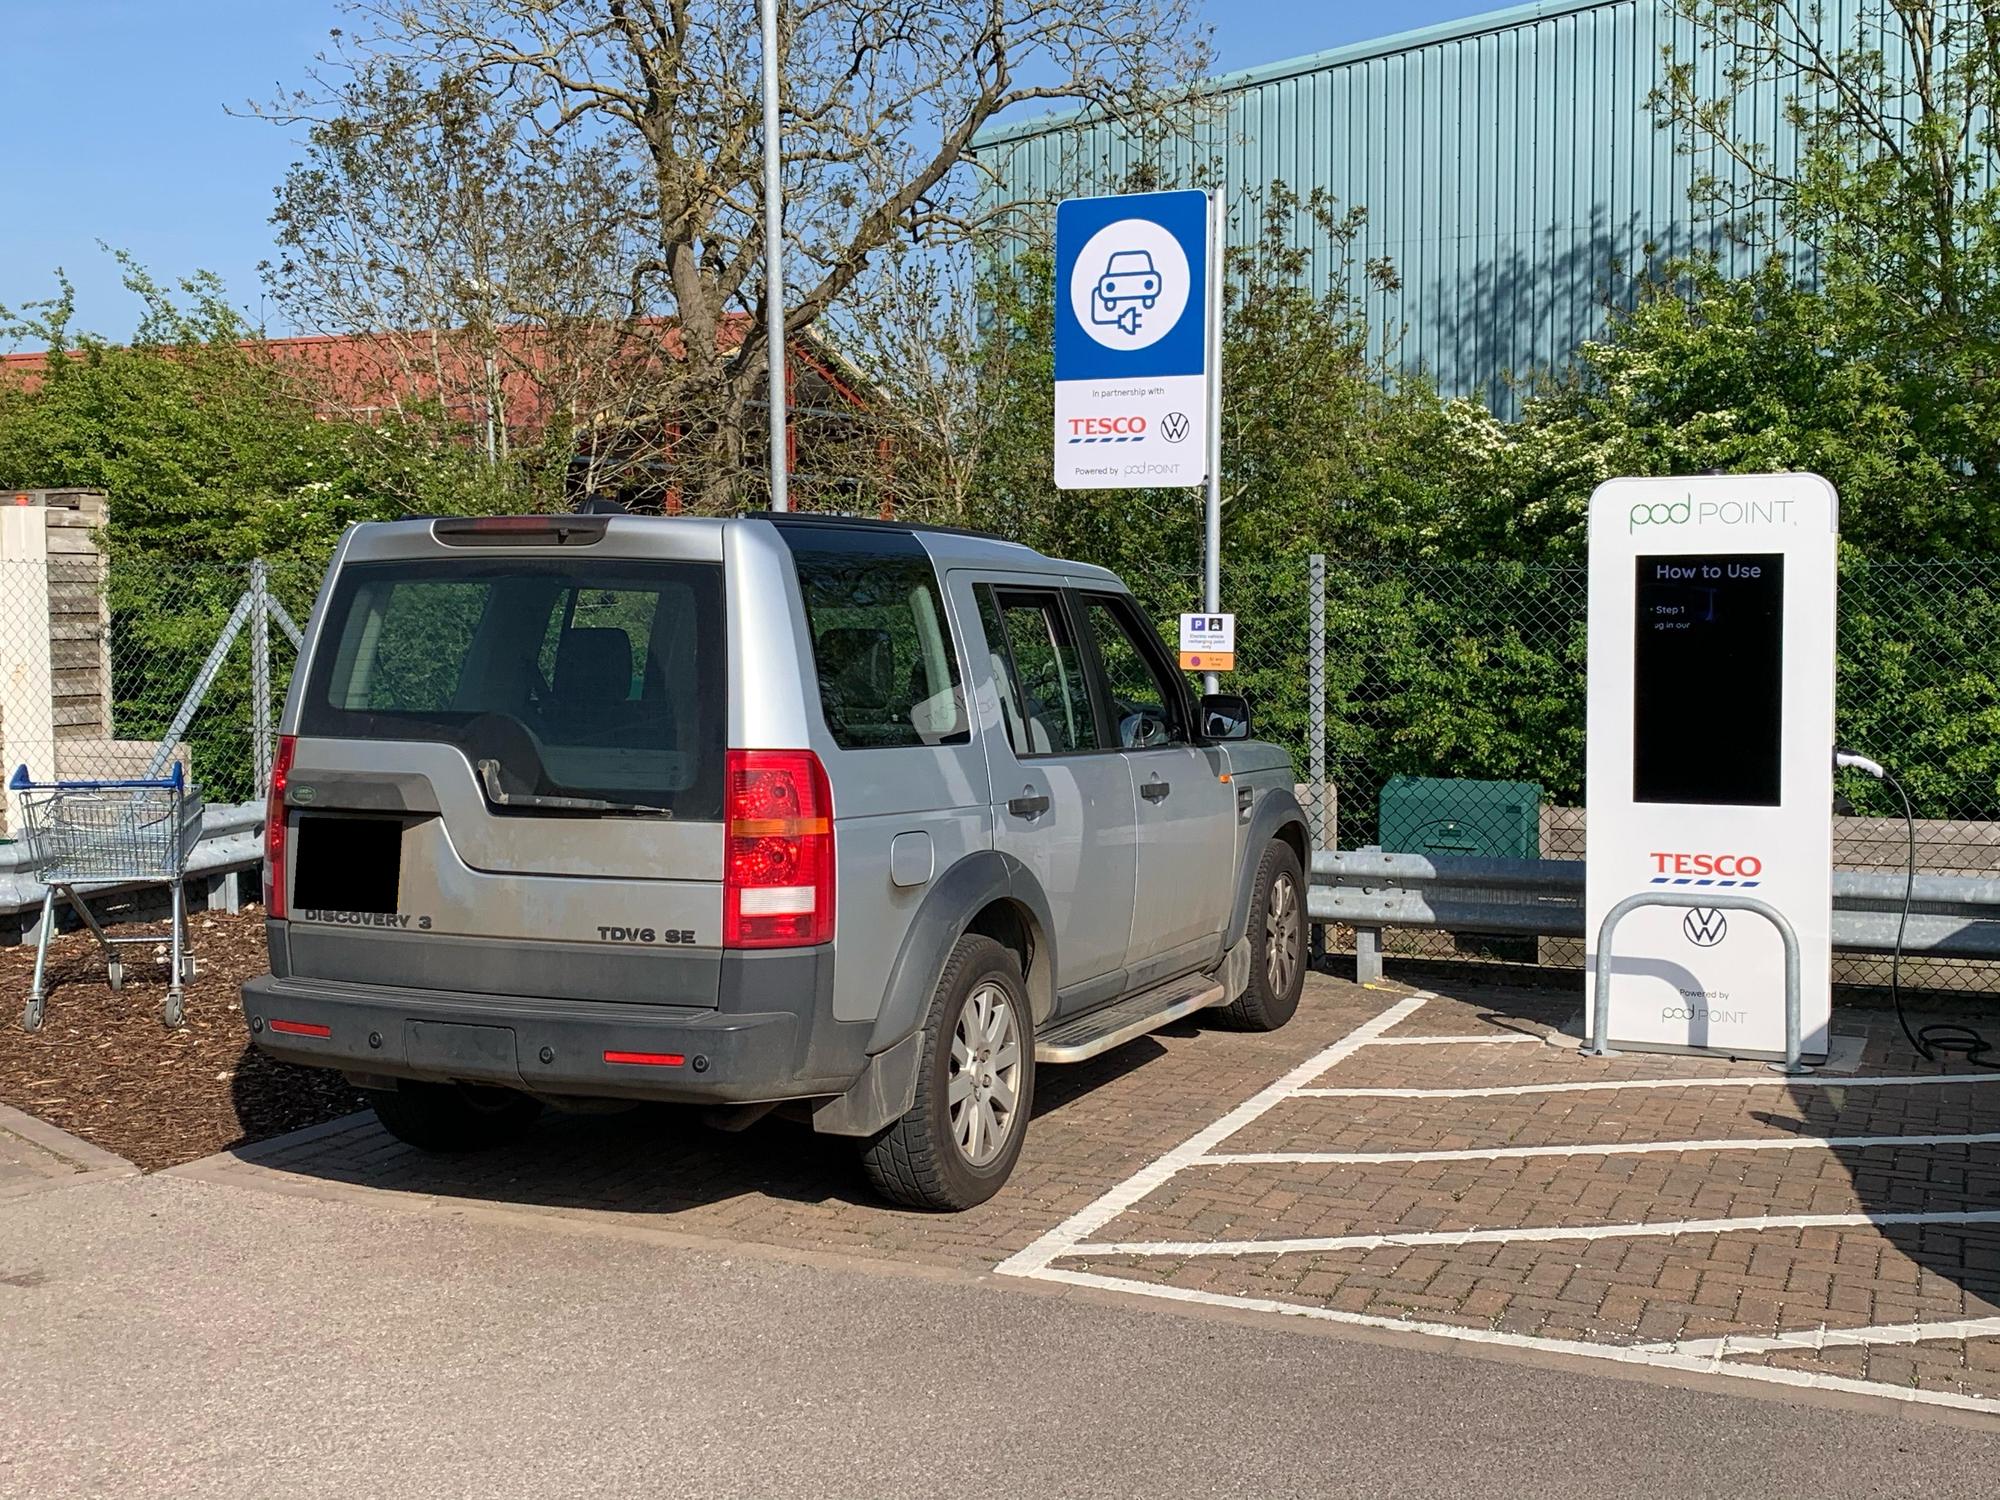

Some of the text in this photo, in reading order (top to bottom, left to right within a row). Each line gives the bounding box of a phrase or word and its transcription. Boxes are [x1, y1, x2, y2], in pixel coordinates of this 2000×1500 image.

[1092, 387, 1164, 399] In partnership with
[1068, 416, 1147, 435] TESCO
[1075, 461, 1181, 478] Powered by pod POINT
[1629, 492, 1795, 535] pod POINT
[1656, 563, 1762, 579] How to Use
[1656, 605, 1685, 615] Step 1
[1666, 620, 1674, 628] in
[1649, 852, 1762, 877] TESCO
[305, 909, 432, 930] DISCOVERY 3
[597, 926, 696, 944] TDV6 SE
[1679, 988, 1730, 1000] Powered by
[1661, 1004, 1748, 1024] pod POINT
